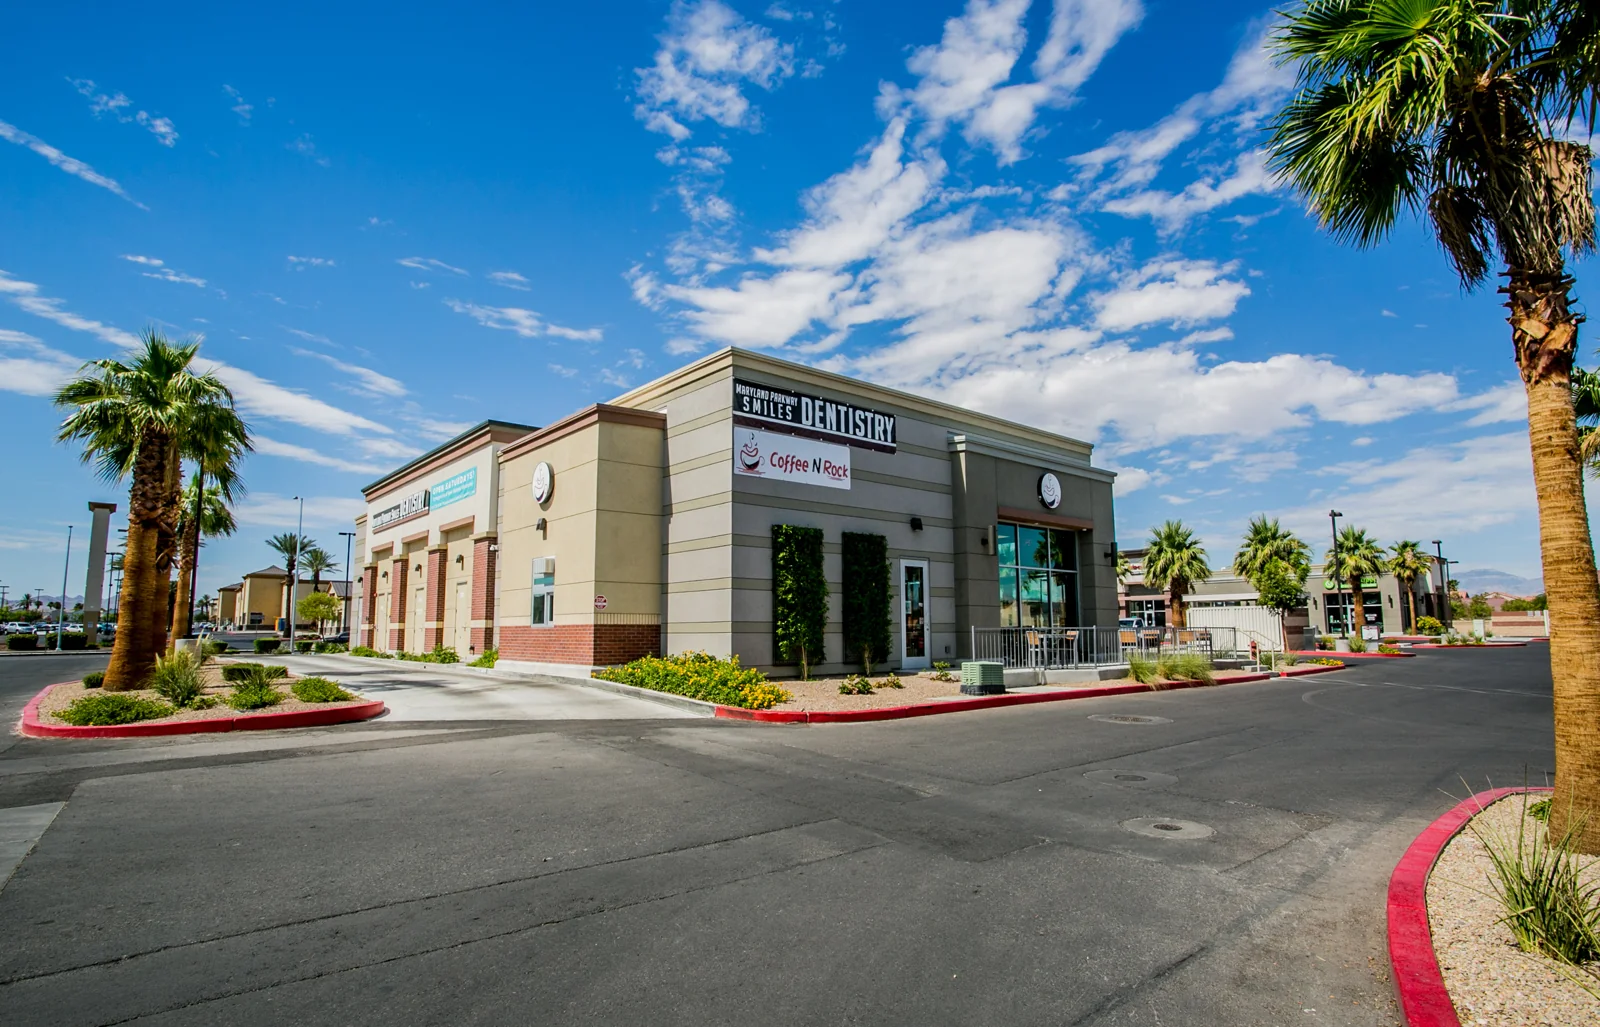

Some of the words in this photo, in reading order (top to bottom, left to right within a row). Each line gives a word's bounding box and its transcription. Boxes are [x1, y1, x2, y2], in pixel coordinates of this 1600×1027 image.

[736, 383, 769, 400] MARYLAND
[770, 391, 798, 407] PARKWAY
[743, 396, 792, 420] SMILES
[801, 396, 894, 442] DENTISTRY
[770, 452, 808, 474] Coffee
[812, 457, 821, 474] N
[823, 460, 848, 478] Rock
